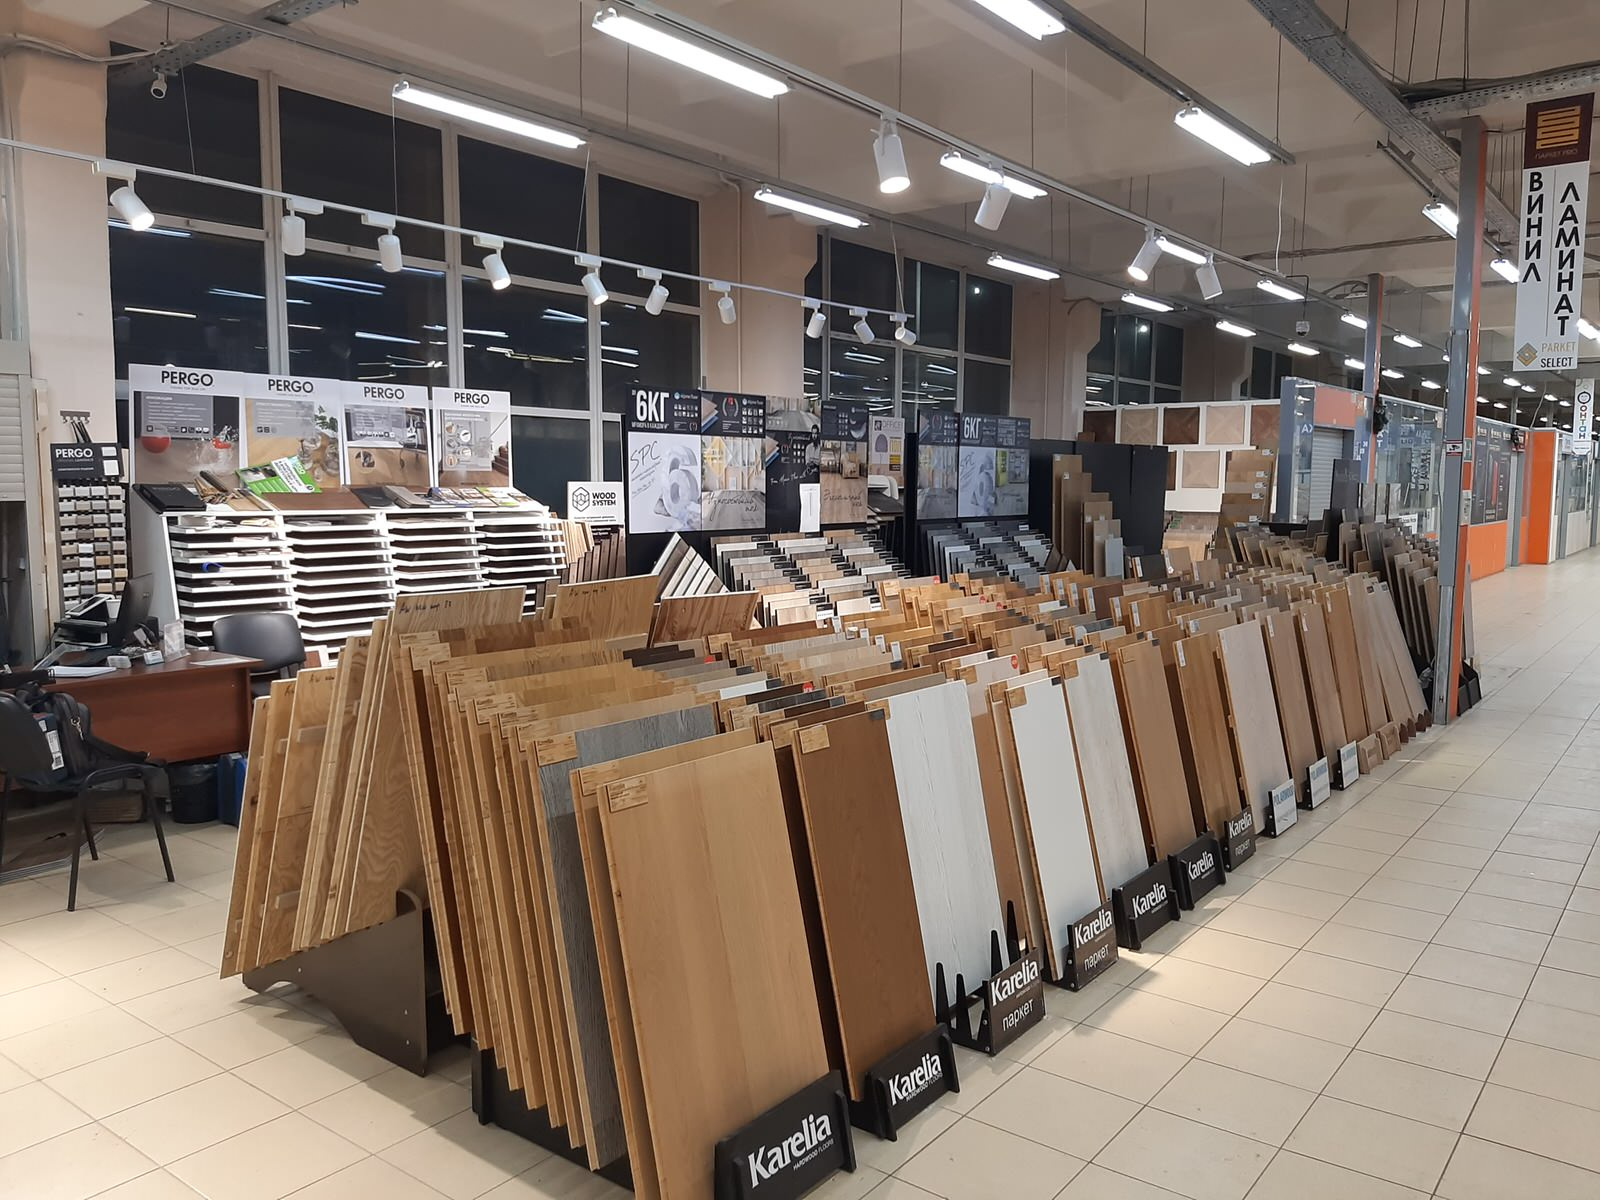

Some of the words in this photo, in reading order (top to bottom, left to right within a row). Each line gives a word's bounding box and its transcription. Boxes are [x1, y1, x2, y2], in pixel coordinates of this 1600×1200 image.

[1522, 171, 1544, 283] ВИНИЛ
[1554, 182, 1581, 336] ЛАМИНАТ
[1540, 357, 1574, 368] SELECT
[1541, 342, 1576, 352] PARKET
[161, 370, 214, 386] PERGO
[268, 378, 314, 394] PERGO
[364, 386, 404, 400] PERGO
[454, 392, 490, 404] PERGO
[636, 390, 670, 422] 6КГ
[55, 448, 93, 458] PERGO
[1228, 811, 1252, 838] Karelia
[1132, 882, 1167, 918] Karelia
[1074, 909, 1113, 949] Karelia
[1084, 944, 1109, 971] паркет
[991, 960, 1038, 1007] Karelia
[1002, 999, 1033, 1031] паркет
[888, 1053, 942, 1106] Karelia
[748, 1114, 832, 1188] Karelia
[793, 1150, 818, 1171] HARDWOOD
[818, 1138, 834, 1154] FLOORS
